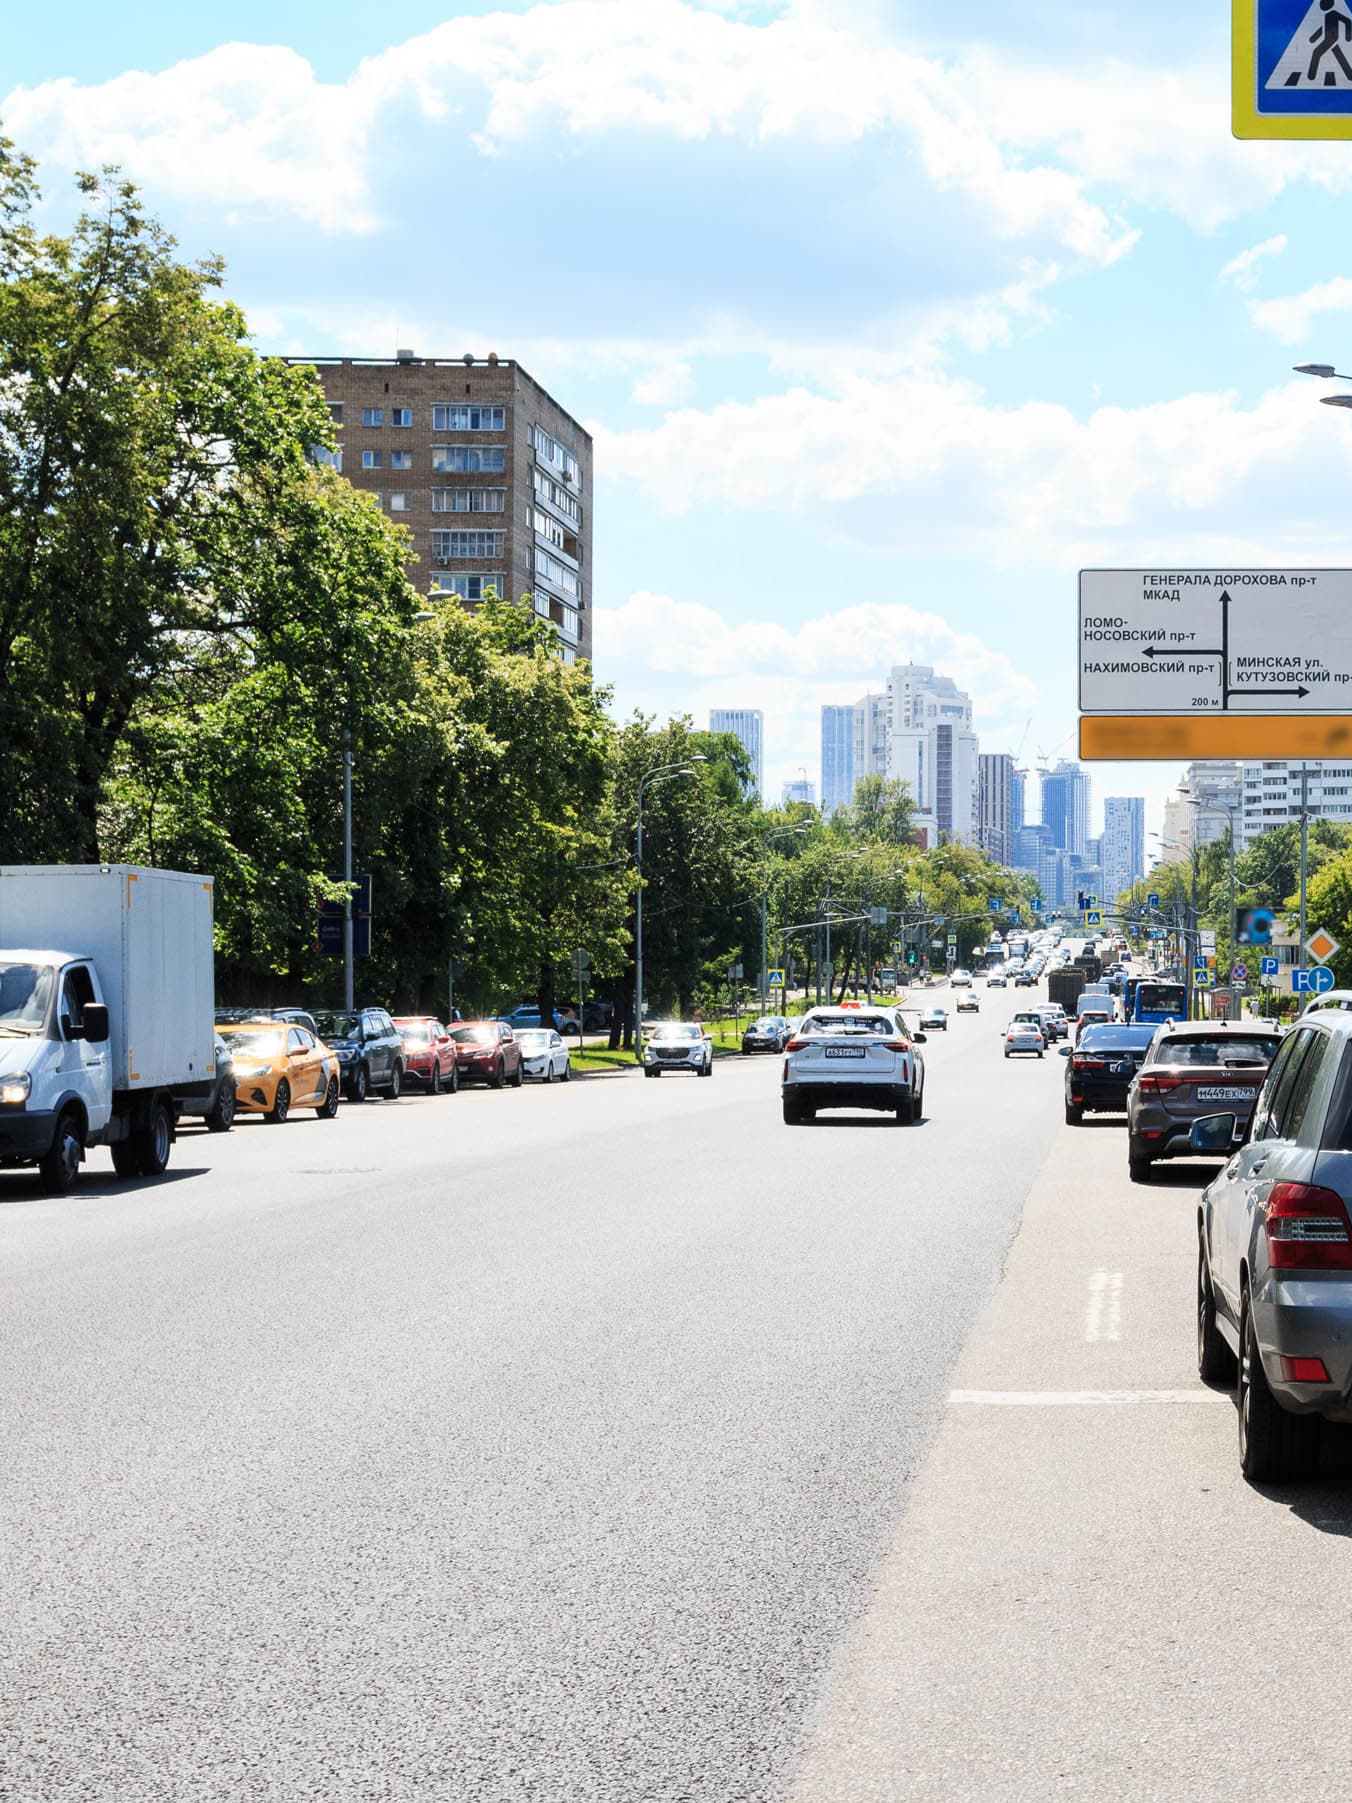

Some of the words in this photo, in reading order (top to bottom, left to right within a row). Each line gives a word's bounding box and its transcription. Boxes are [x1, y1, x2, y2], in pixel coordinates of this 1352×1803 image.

[1143, 575, 1211, 586] ГЕНЕРАЛА
[1213, 575, 1287, 587] ДОРОХОВА
[1290, 577, 1317, 588] пр-т
[1143, 590, 1181, 601] МКАД
[1084, 618, 1128, 628] ЛОМО-
[1084, 629, 1166, 641] НОСОВСКИЙ
[1170, 633, 1196, 643] пр-т
[1084, 662, 1184, 673] НАХИМОВСКИЙ
[1188, 664, 1215, 675] пр-т
[1237, 657, 1301, 668] МИНСКАЯ
[1304, 659, 1324, 670] ул.
[1237, 671, 1330, 683] КУТУЗОВСКИЙ
[1192, 698, 1209, 706] 200
